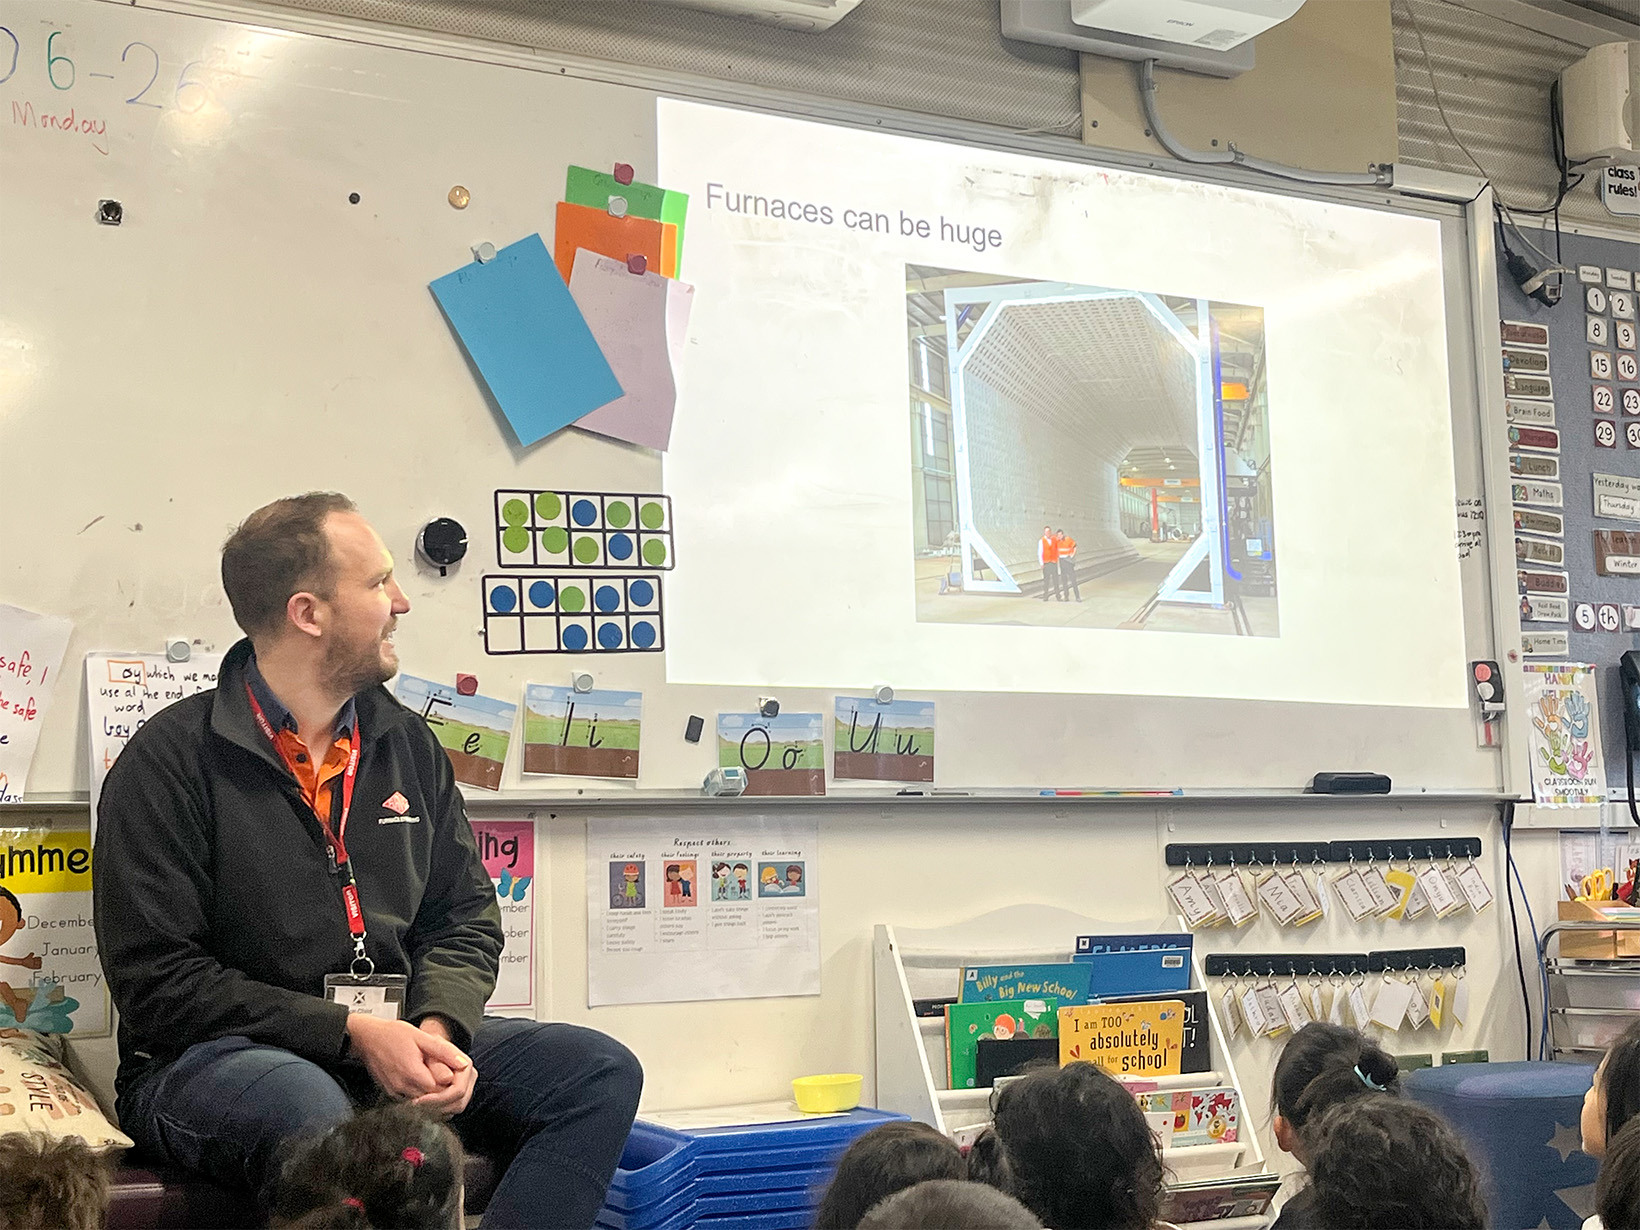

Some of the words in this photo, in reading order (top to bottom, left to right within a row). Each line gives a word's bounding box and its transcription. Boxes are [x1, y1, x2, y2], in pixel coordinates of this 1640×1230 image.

[12, 100, 110, 156] Monday
[1608, 166, 1636, 181] class
[1608, 183, 1638, 198] rules!
[705, 182, 835, 226] Furnaces
[843, 208, 890, 234] can
[899, 210, 931, 239] be
[940, 215, 1004, 253] huge
[1593, 293, 1600, 307] 1
[1617, 298, 1625, 312] 2
[1592, 323, 1601, 338] 8
[1622, 328, 1631, 342] 9
[1595, 358, 1608, 373] 15
[1621, 360, 1635, 374] 16
[1596, 391, 1611, 407] 22
[1625, 394, 1639, 409] 23
[1513, 405, 1532, 416] Brain
[1533, 407, 1551, 418] Food
[1597, 426, 1613, 441] 29
[1532, 488, 1554, 499] Maths
[1593, 477, 1630, 494] Yesterday
[1603, 498, 1635, 515] Thursday
[1614, 559, 1638, 569] Winter
[1582, 609, 1590, 624] 5
[1600, 607, 1616, 625] th
[0, 650, 32, 686] safe,
[146, 664, 175, 682] which
[183, 671, 199, 683] we
[100, 686, 119, 698] use
[13, 696, 37, 722] safe
[114, 700, 146, 715] word
[673, 837, 704, 849] Respect
[706, 837, 731, 847] others
[776, 849, 801, 857] learning
[1178, 885, 1202, 917] Amy
[1266, 885, 1288, 912] Mia
[33, 970, 102, 987] February
[976, 975, 998, 993] Billy
[1000, 970, 1013, 981] and
[1013, 970, 1025, 978] the
[998, 985, 1015, 999] Big
[1017, 981, 1042, 993] New
[1042, 980, 1078, 1000] School
[1262, 993, 1279, 1023] Judah
[1073, 1019, 1080, 1033] I
[1083, 1021, 1098, 1030] am
[1101, 1016, 1122, 1029] TOO
[1089, 1028, 1159, 1051] absolutely
[1107, 1055, 1119, 1064] for
[1121, 1048, 1168, 1072] school
[21, 1072, 54, 1112] STYLE
